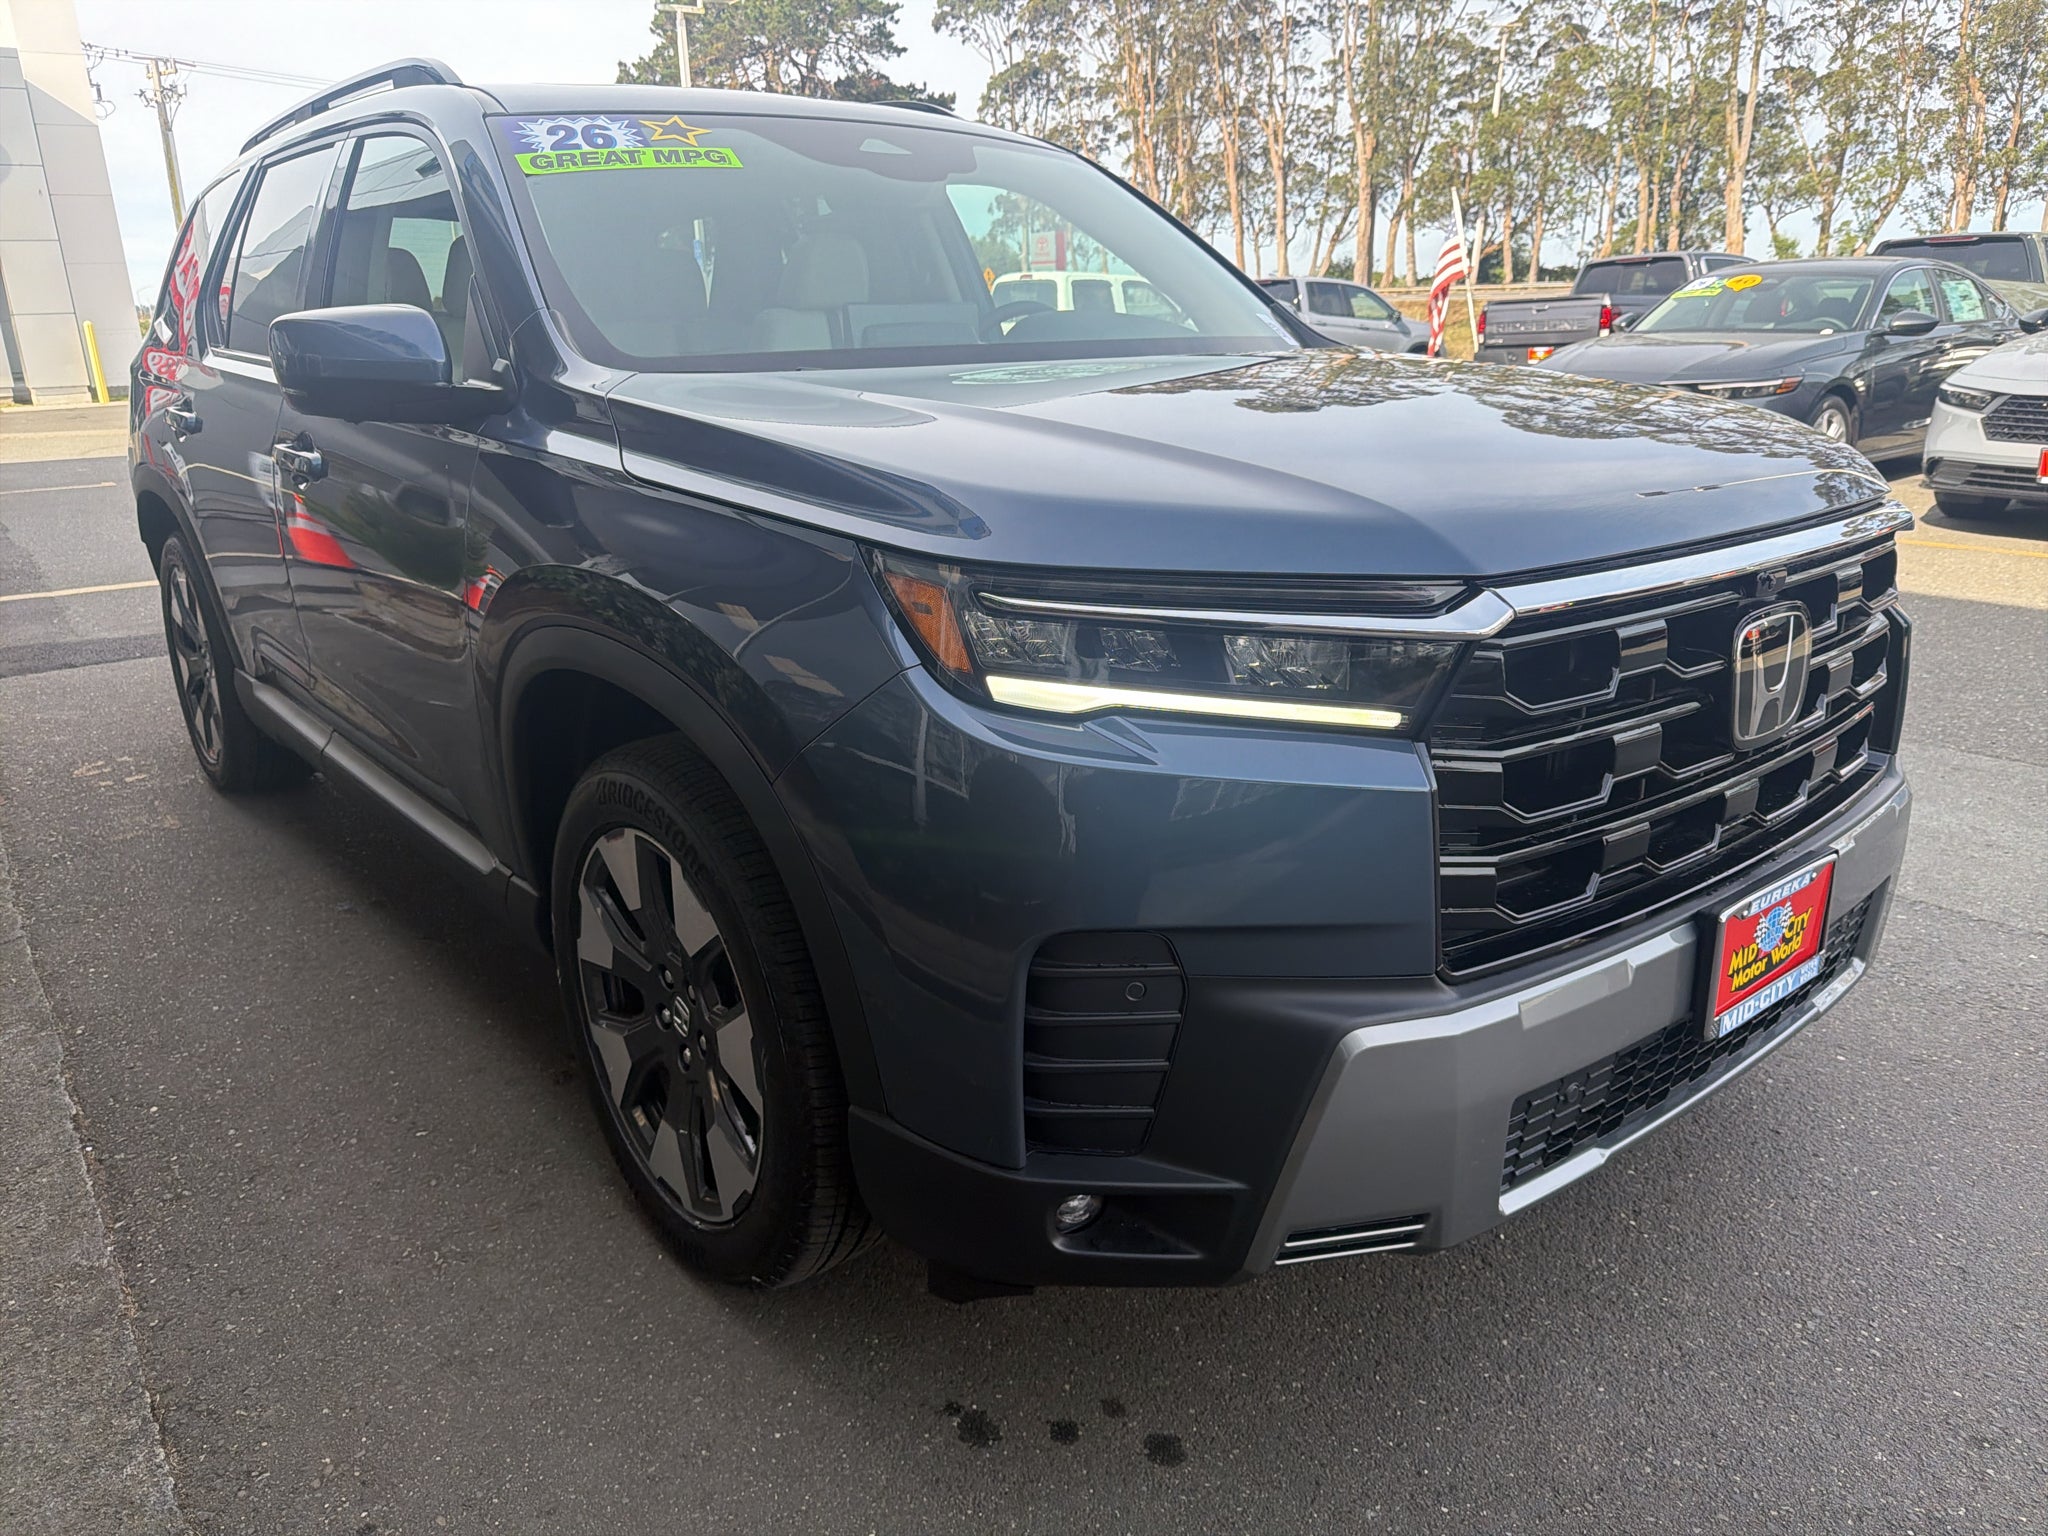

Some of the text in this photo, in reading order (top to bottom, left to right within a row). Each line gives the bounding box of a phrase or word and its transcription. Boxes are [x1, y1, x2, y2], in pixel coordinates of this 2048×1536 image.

[546, 124, 617, 151] 26
[529, 148, 729, 170] GREAT MPG
[1751, 872, 1811, 913] EUREKA
[1728, 907, 1813, 976] MID CITY
[1731, 957, 1768, 992] Motor
[1771, 931, 1803, 966] World
